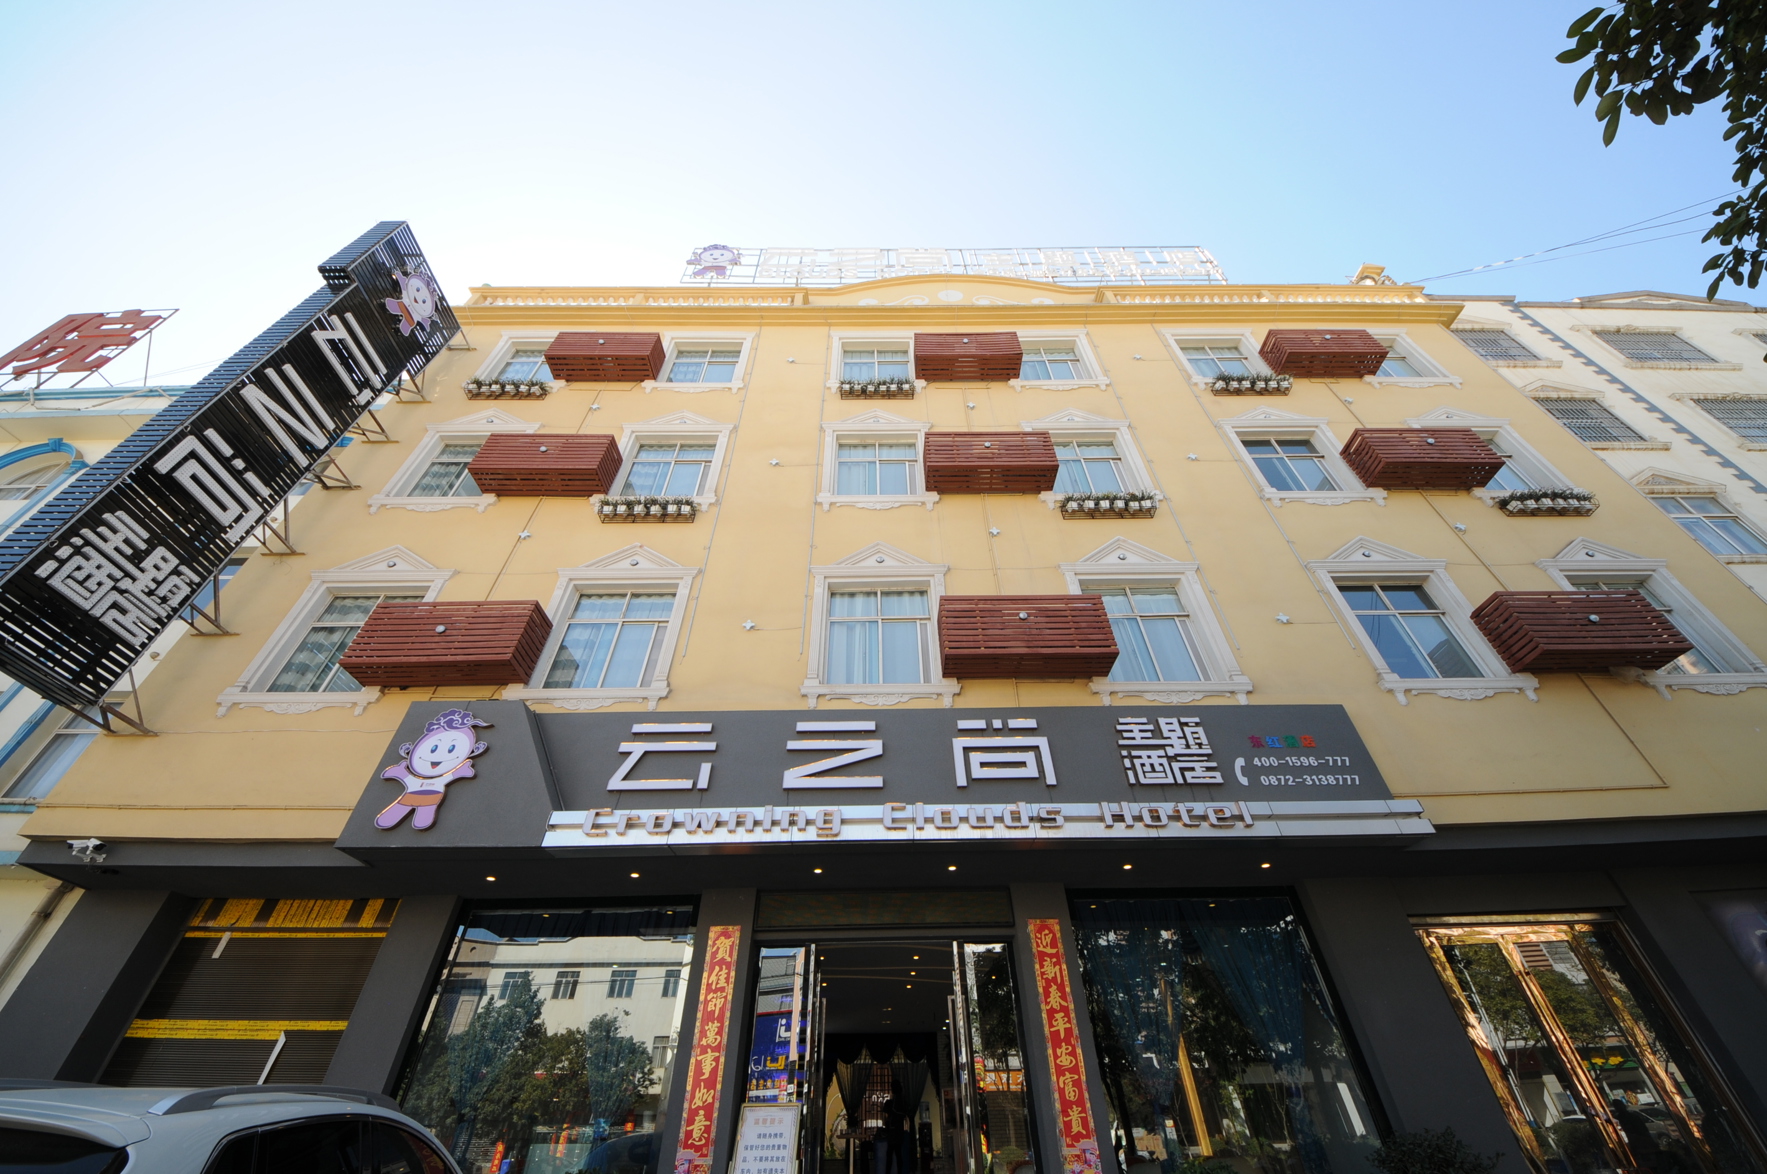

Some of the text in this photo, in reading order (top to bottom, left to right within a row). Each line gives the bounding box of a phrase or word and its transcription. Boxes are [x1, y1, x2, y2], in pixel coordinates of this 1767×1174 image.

[154, 312, 388, 544] 云之尚
[606, 717, 1058, 792] 云之尚
[1253, 756, 1350, 767] 400-1596-777
[1260, 775, 1359, 786] 0872-3138777
[582, 799, 1255, 838] Crowning Clouds Hotel
